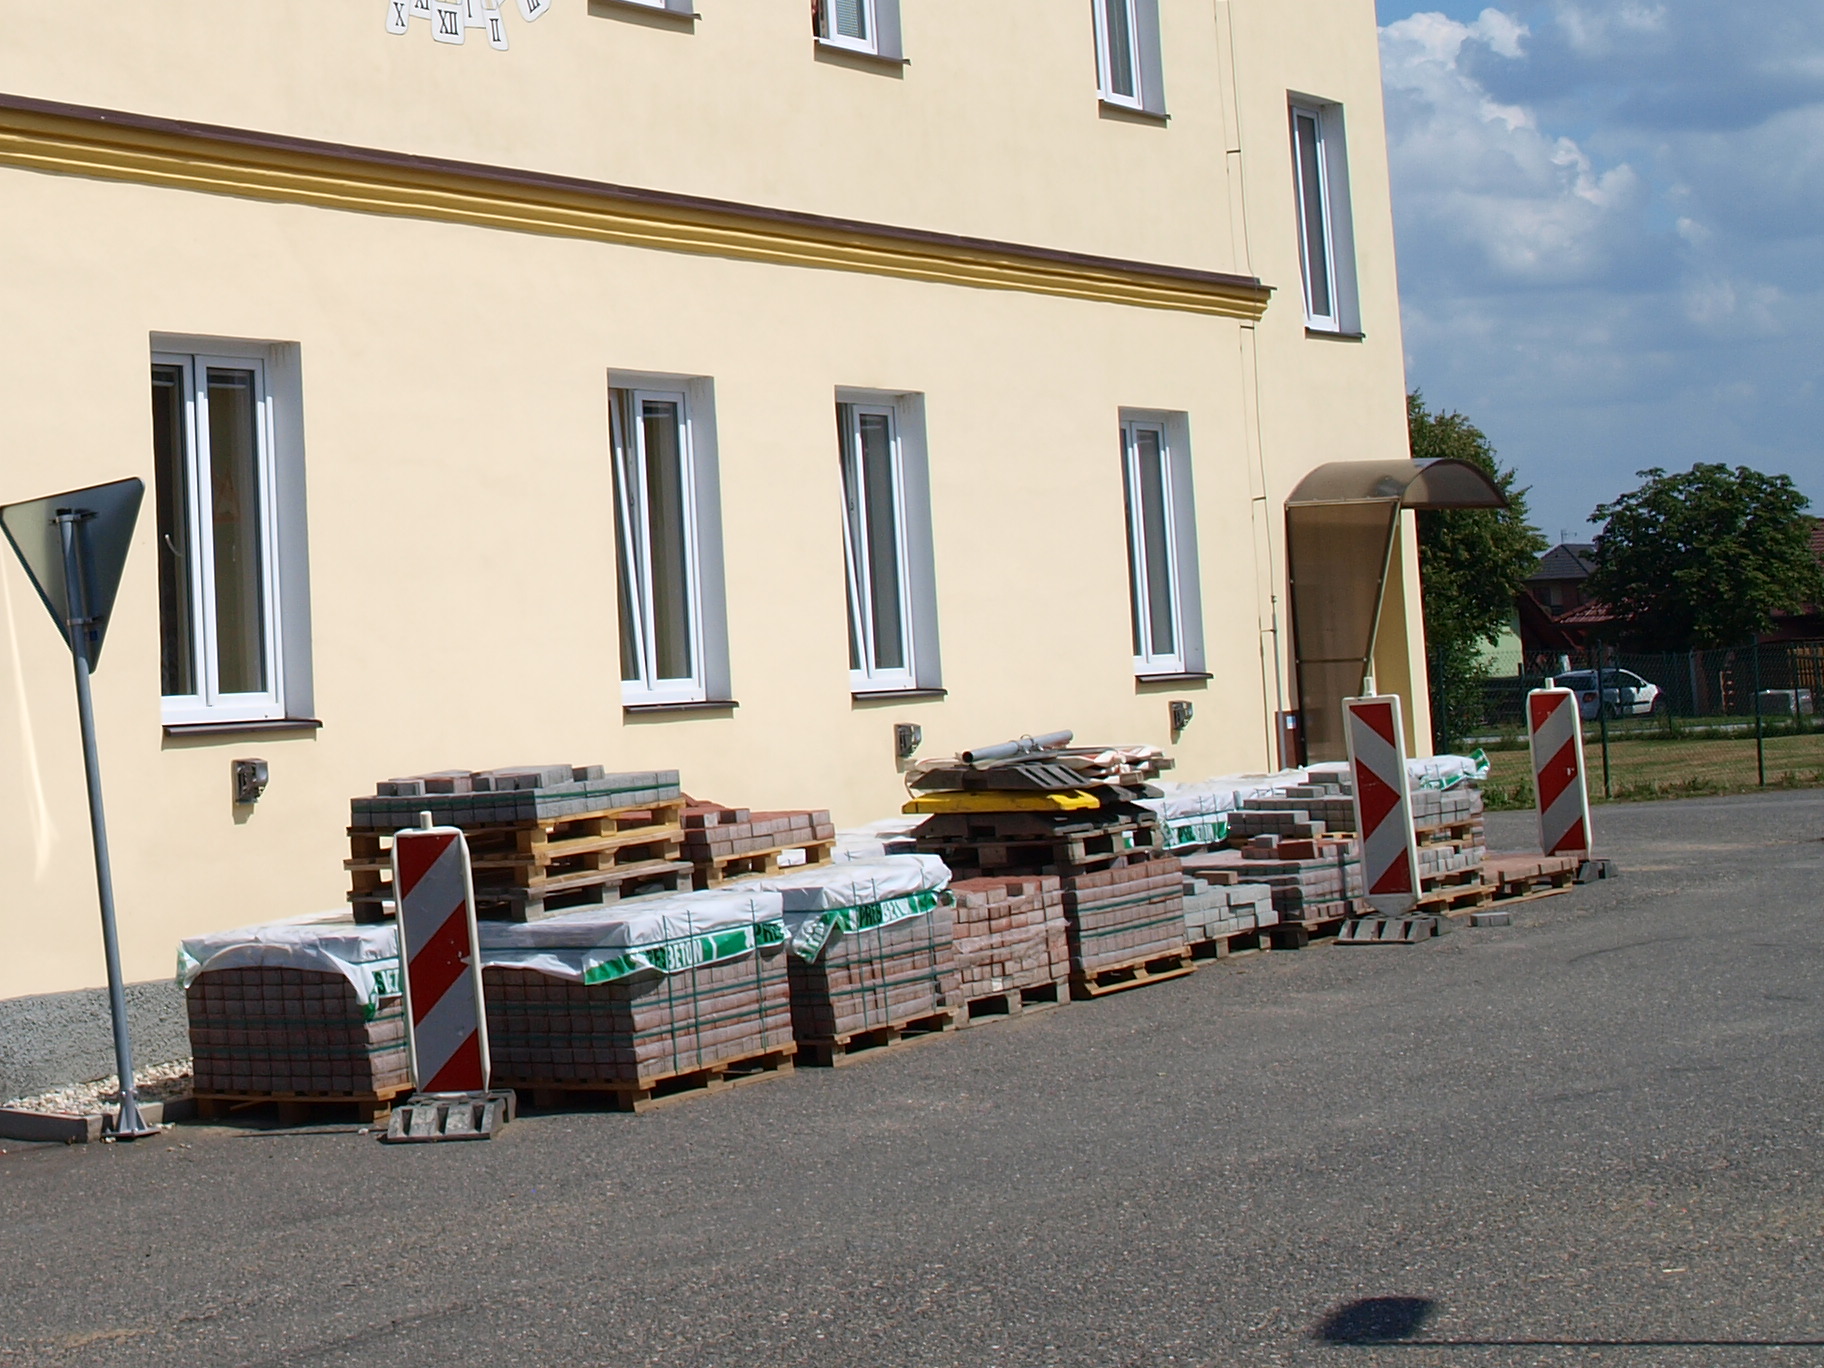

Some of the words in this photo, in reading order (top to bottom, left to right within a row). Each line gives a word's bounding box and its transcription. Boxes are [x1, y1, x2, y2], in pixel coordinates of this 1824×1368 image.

[393, 3, 406, 27] X
[438, 10, 460, 36] XII
[490, 19, 502, 43] II
